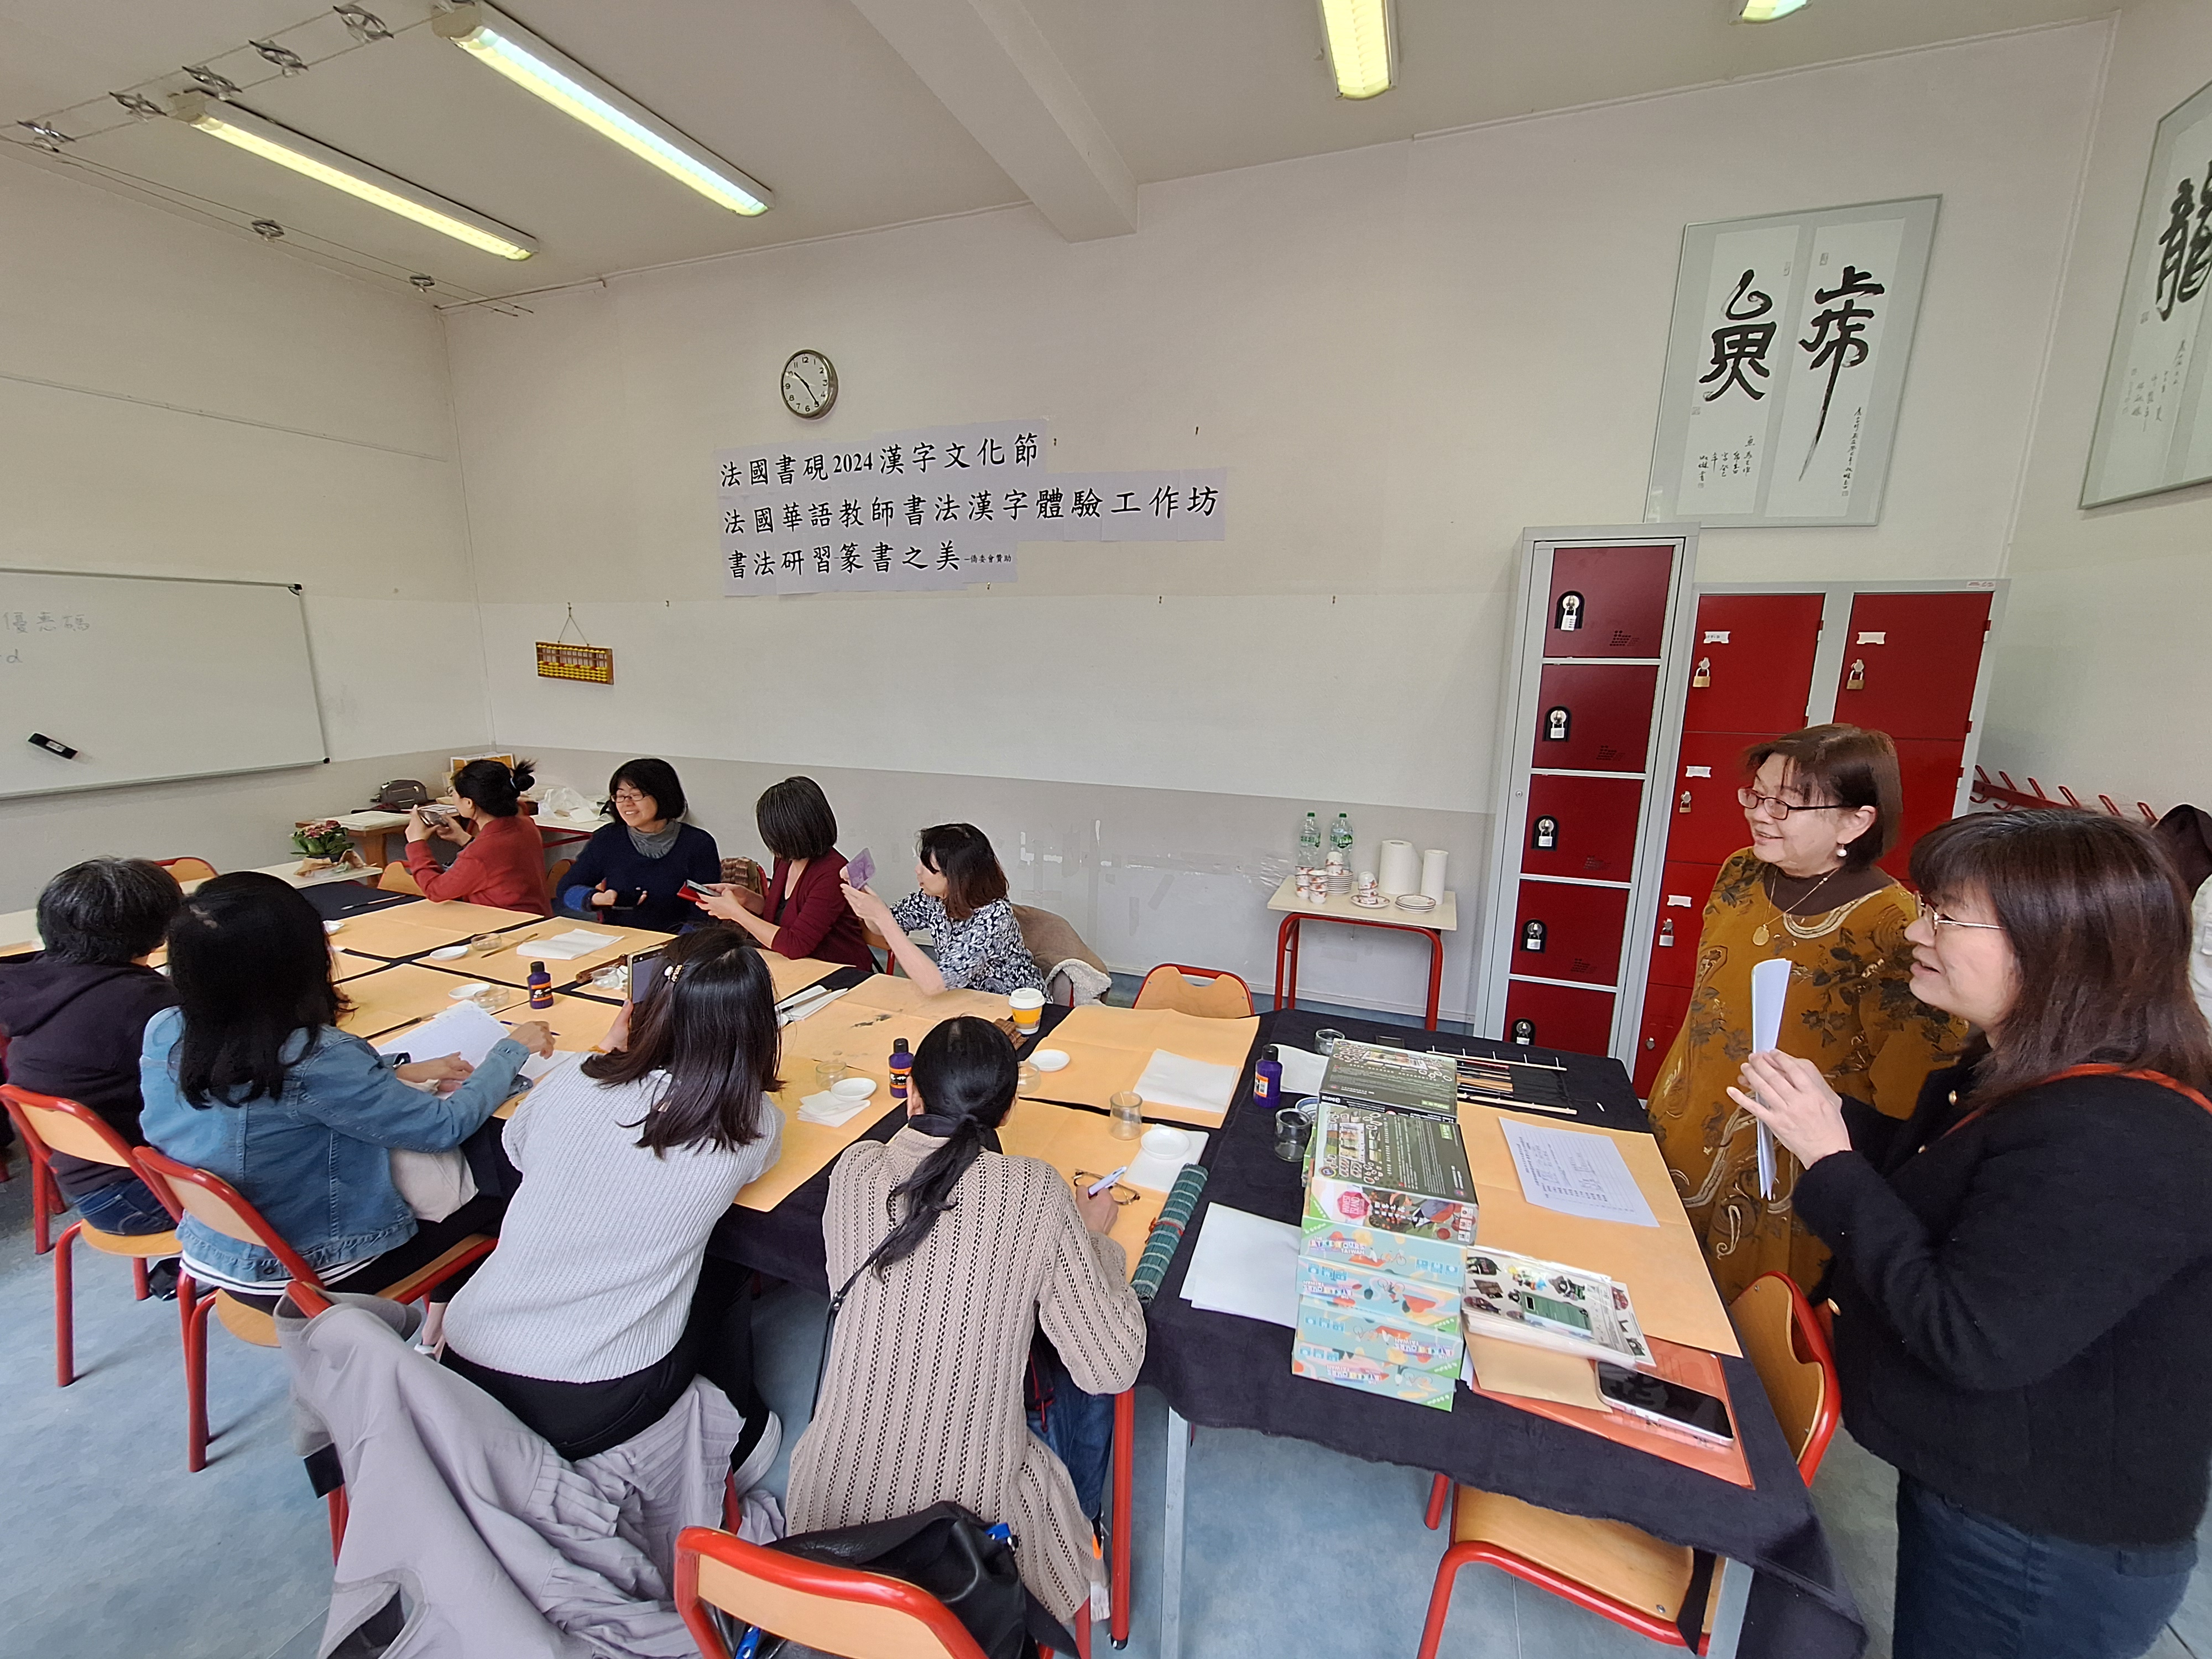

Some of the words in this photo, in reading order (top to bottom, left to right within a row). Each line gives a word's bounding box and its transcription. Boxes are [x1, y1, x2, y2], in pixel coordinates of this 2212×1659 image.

[721, 432, 1037, 487] 法國書硯2024漢字文化節
[724, 486, 1218, 534] 法國華語教師書法漢字體驗工作坊
[1342, 1195, 1350, 1213] HARVEST
[1350, 1197, 1360, 1214] ISLAND
